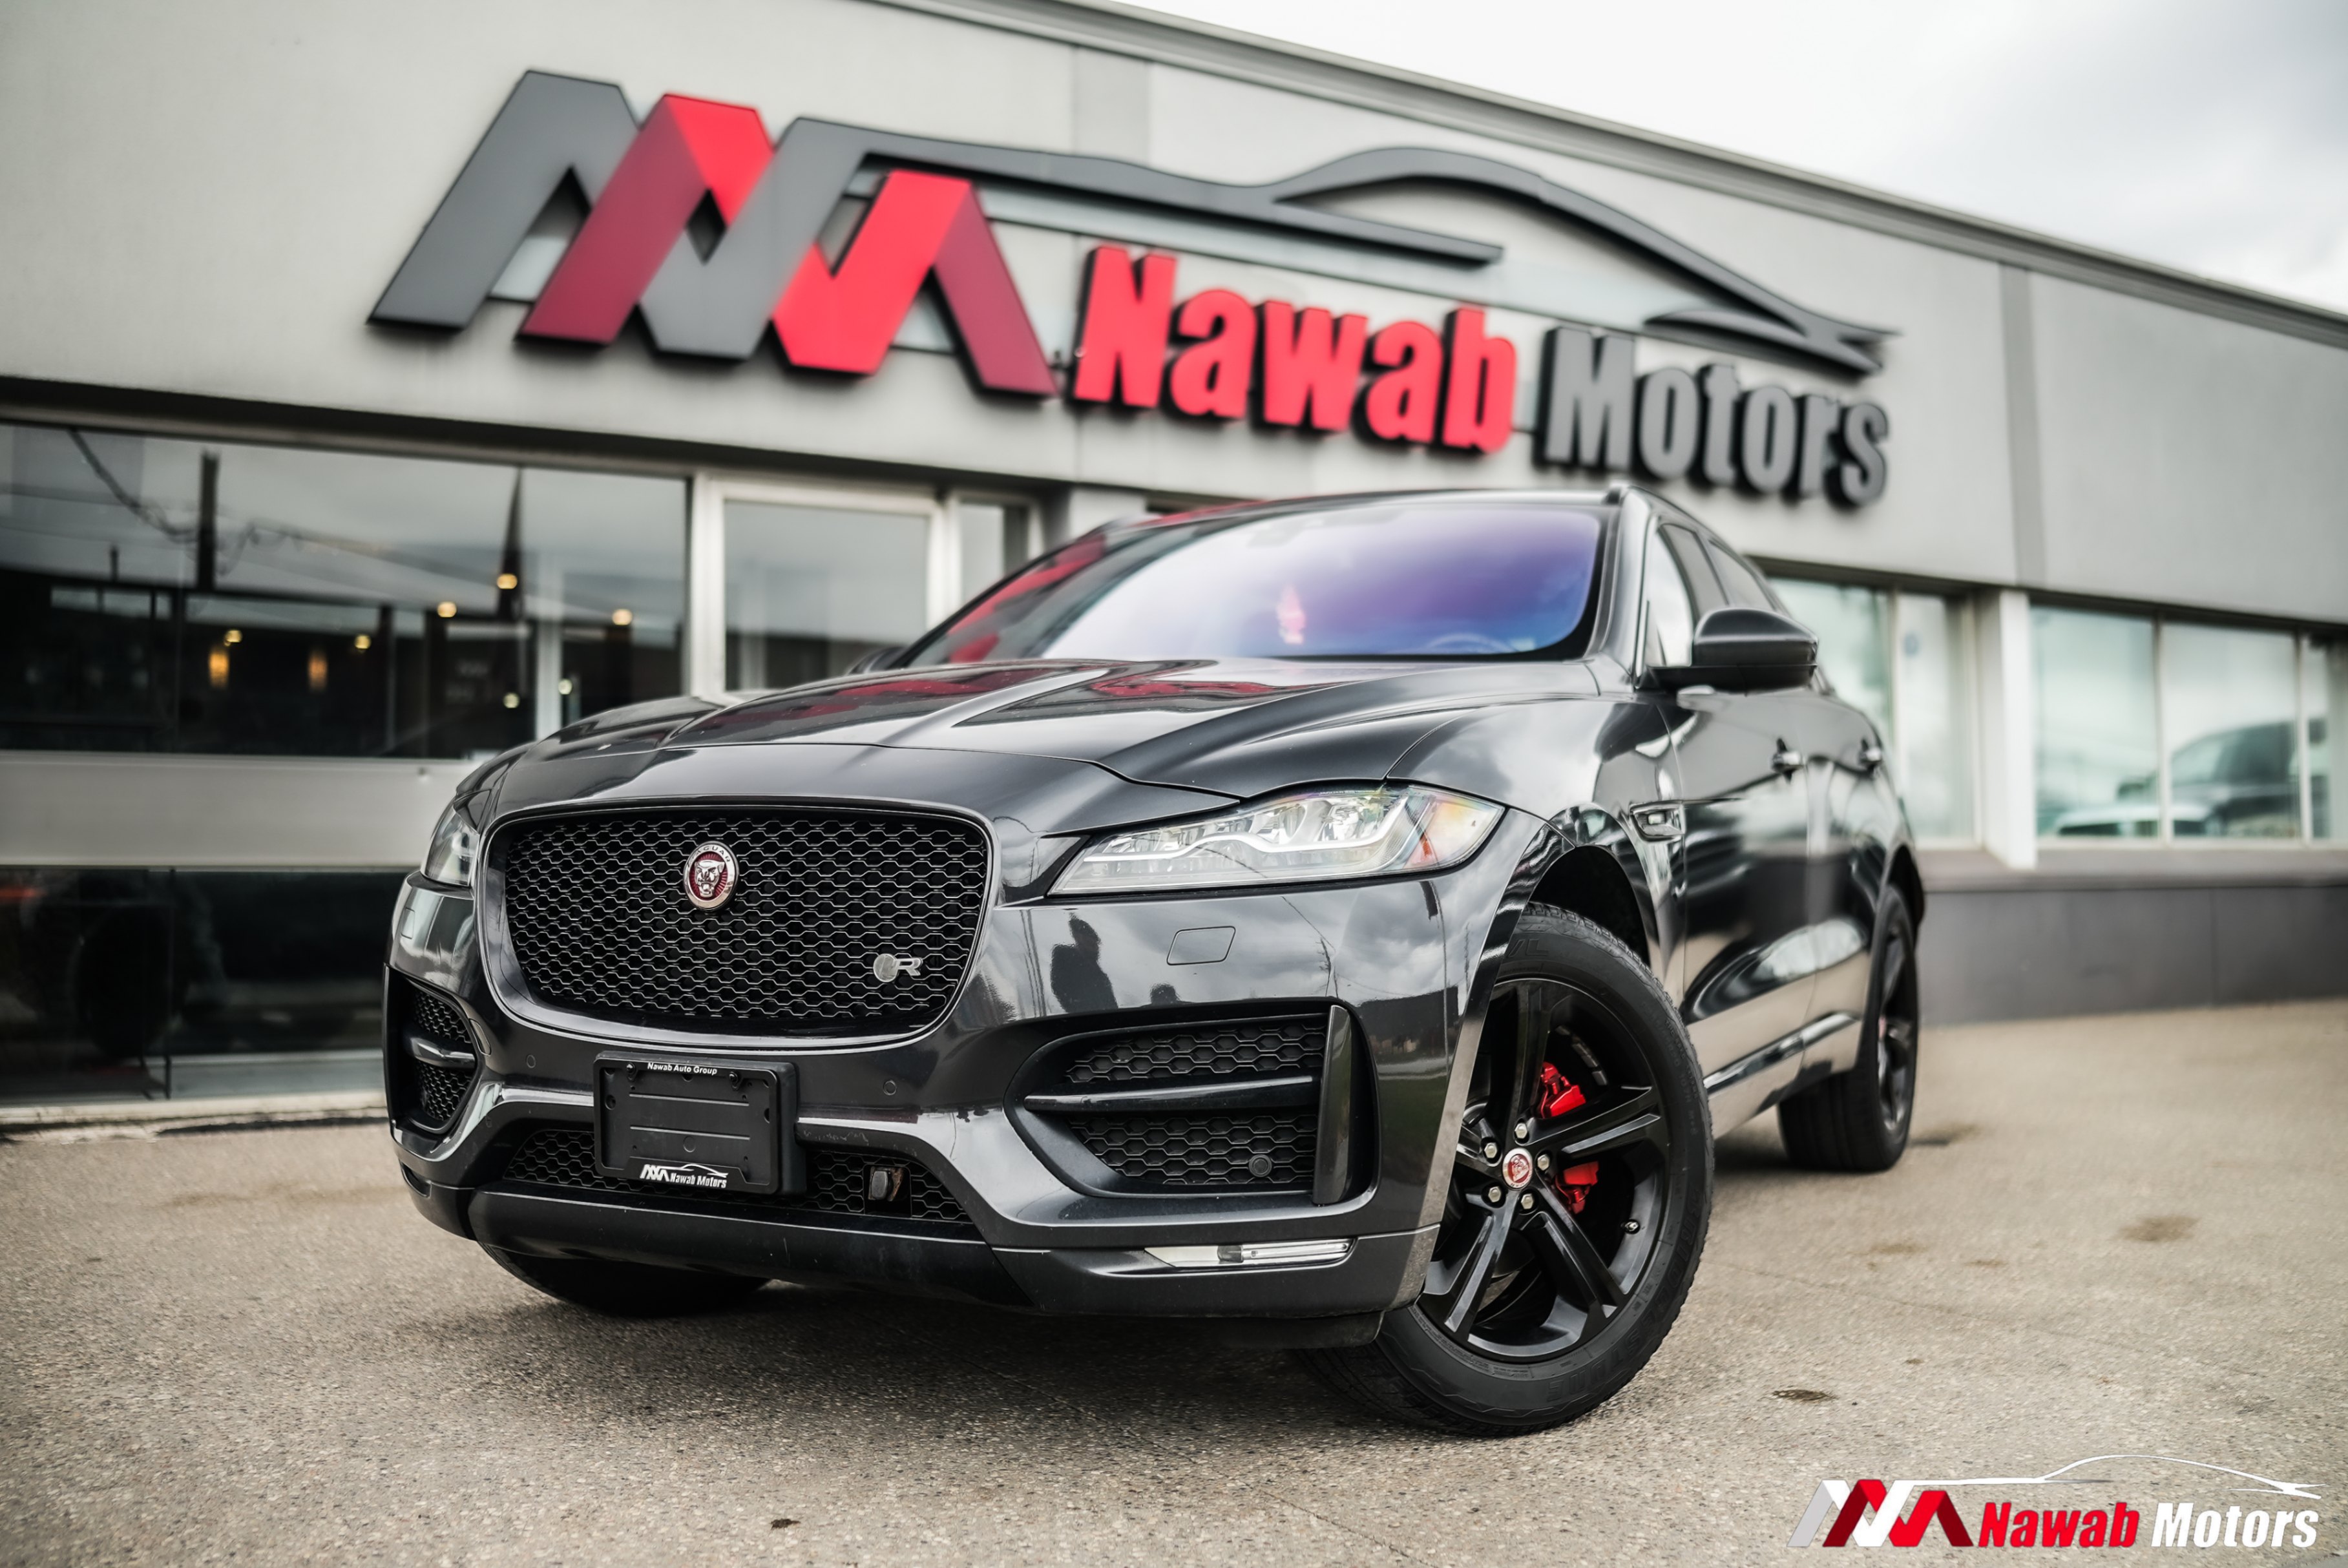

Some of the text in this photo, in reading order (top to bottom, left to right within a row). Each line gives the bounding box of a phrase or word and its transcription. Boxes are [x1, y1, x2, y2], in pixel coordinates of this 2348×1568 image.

[1074, 244, 1889, 507] Nawab Motors
[647, 1061, 717, 1076] Nawab Auto Group
[670, 1172, 728, 1189] Nawab Motors
[1546, 1187, 1702, 1402] BRIDGESTONE
